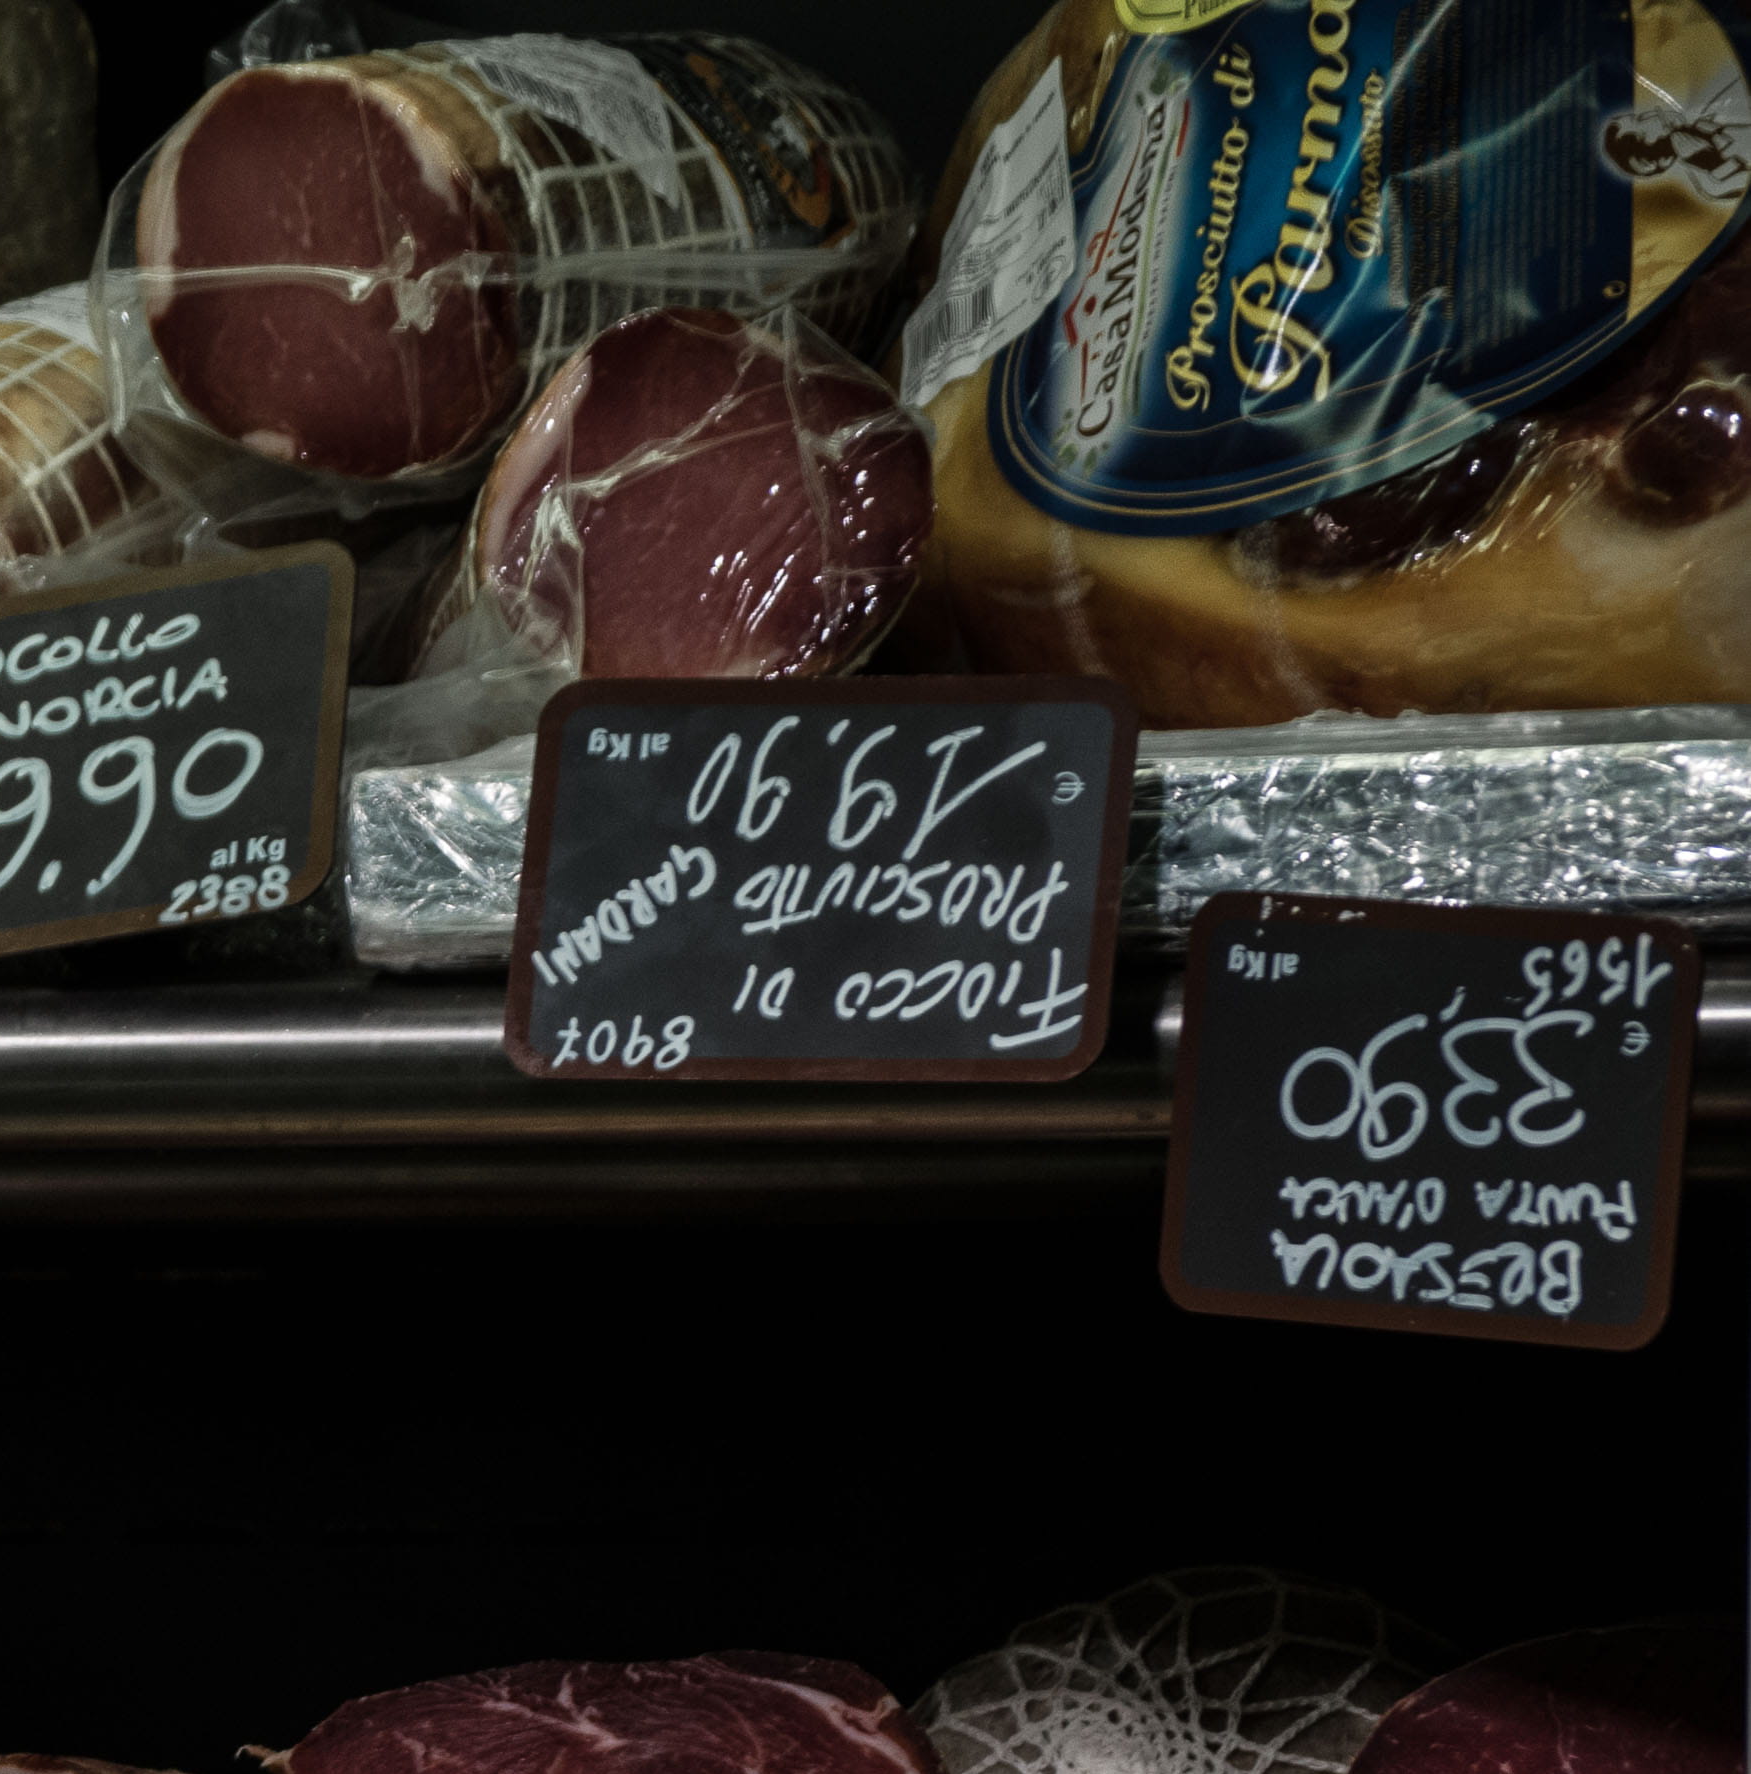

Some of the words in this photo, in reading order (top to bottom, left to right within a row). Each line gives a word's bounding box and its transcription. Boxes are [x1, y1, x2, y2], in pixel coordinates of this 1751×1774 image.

[1344, 69, 1386, 260] Disossato
[1165, 117, 1250, 413] Prosciutto
[1212, 43, 1256, 109] di
[1229, 0, 1356, 402] Parma
[587, 727, 631, 760] Kg
[641, 731, 672, 757] al
[1051, 770, 1087, 802] €
[211, 844, 240, 870] al
[245, 835, 287, 866] Kg
[158, 864, 292, 924] 2388
[531, 844, 719, 988] GARDANI
[733, 860, 1069, 944] PROSCIUTTO
[732, 964, 796, 1019] DI
[1227, 943, 1266, 980] Kg
[1273, 950, 1300, 981] al
[833, 948, 1089, 1052] FIOCCO
[552, 1015, 696, 1071] 8907
[1618, 1020, 1652, 1056] €
[1280, 985, 1596, 1162] 33,90
[1474, 1178, 1638, 1243] PUNTA
[1269, 1229, 1583, 1317] BRESAOLA
